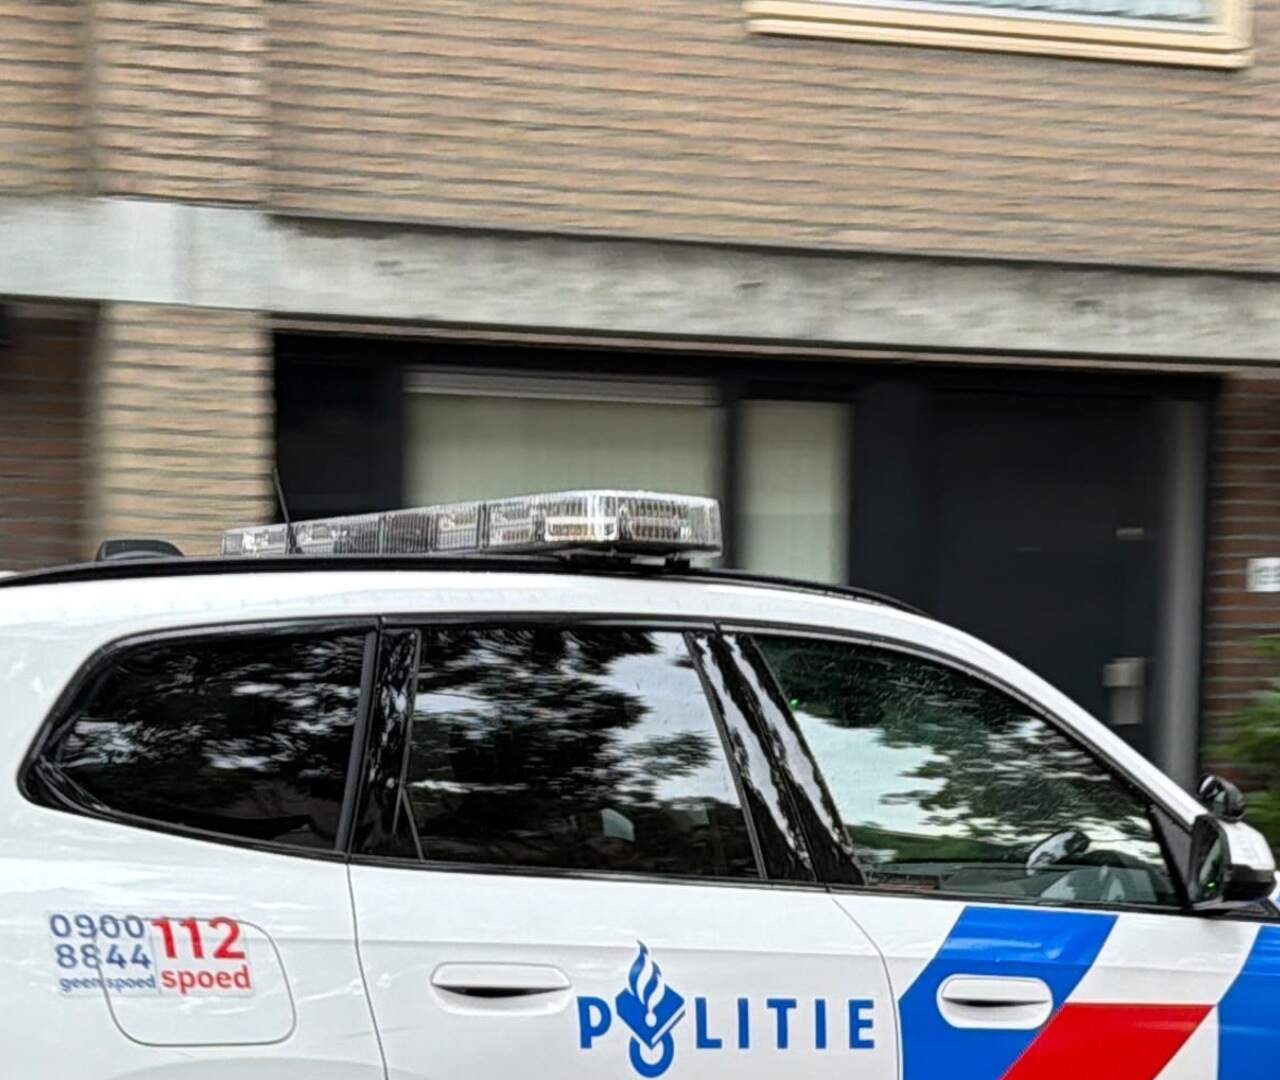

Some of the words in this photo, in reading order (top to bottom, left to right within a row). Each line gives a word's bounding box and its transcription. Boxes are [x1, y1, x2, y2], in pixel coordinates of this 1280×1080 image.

[49, 914, 145, 939] 0900
[151, 916, 246, 959] 112
[55, 943, 152, 969] 8844
[59, 978, 103, 993] geen
[107, 974, 157, 992] spoed
[161, 965, 252, 995] spoed
[576, 990, 876, 1079] POLITIE
